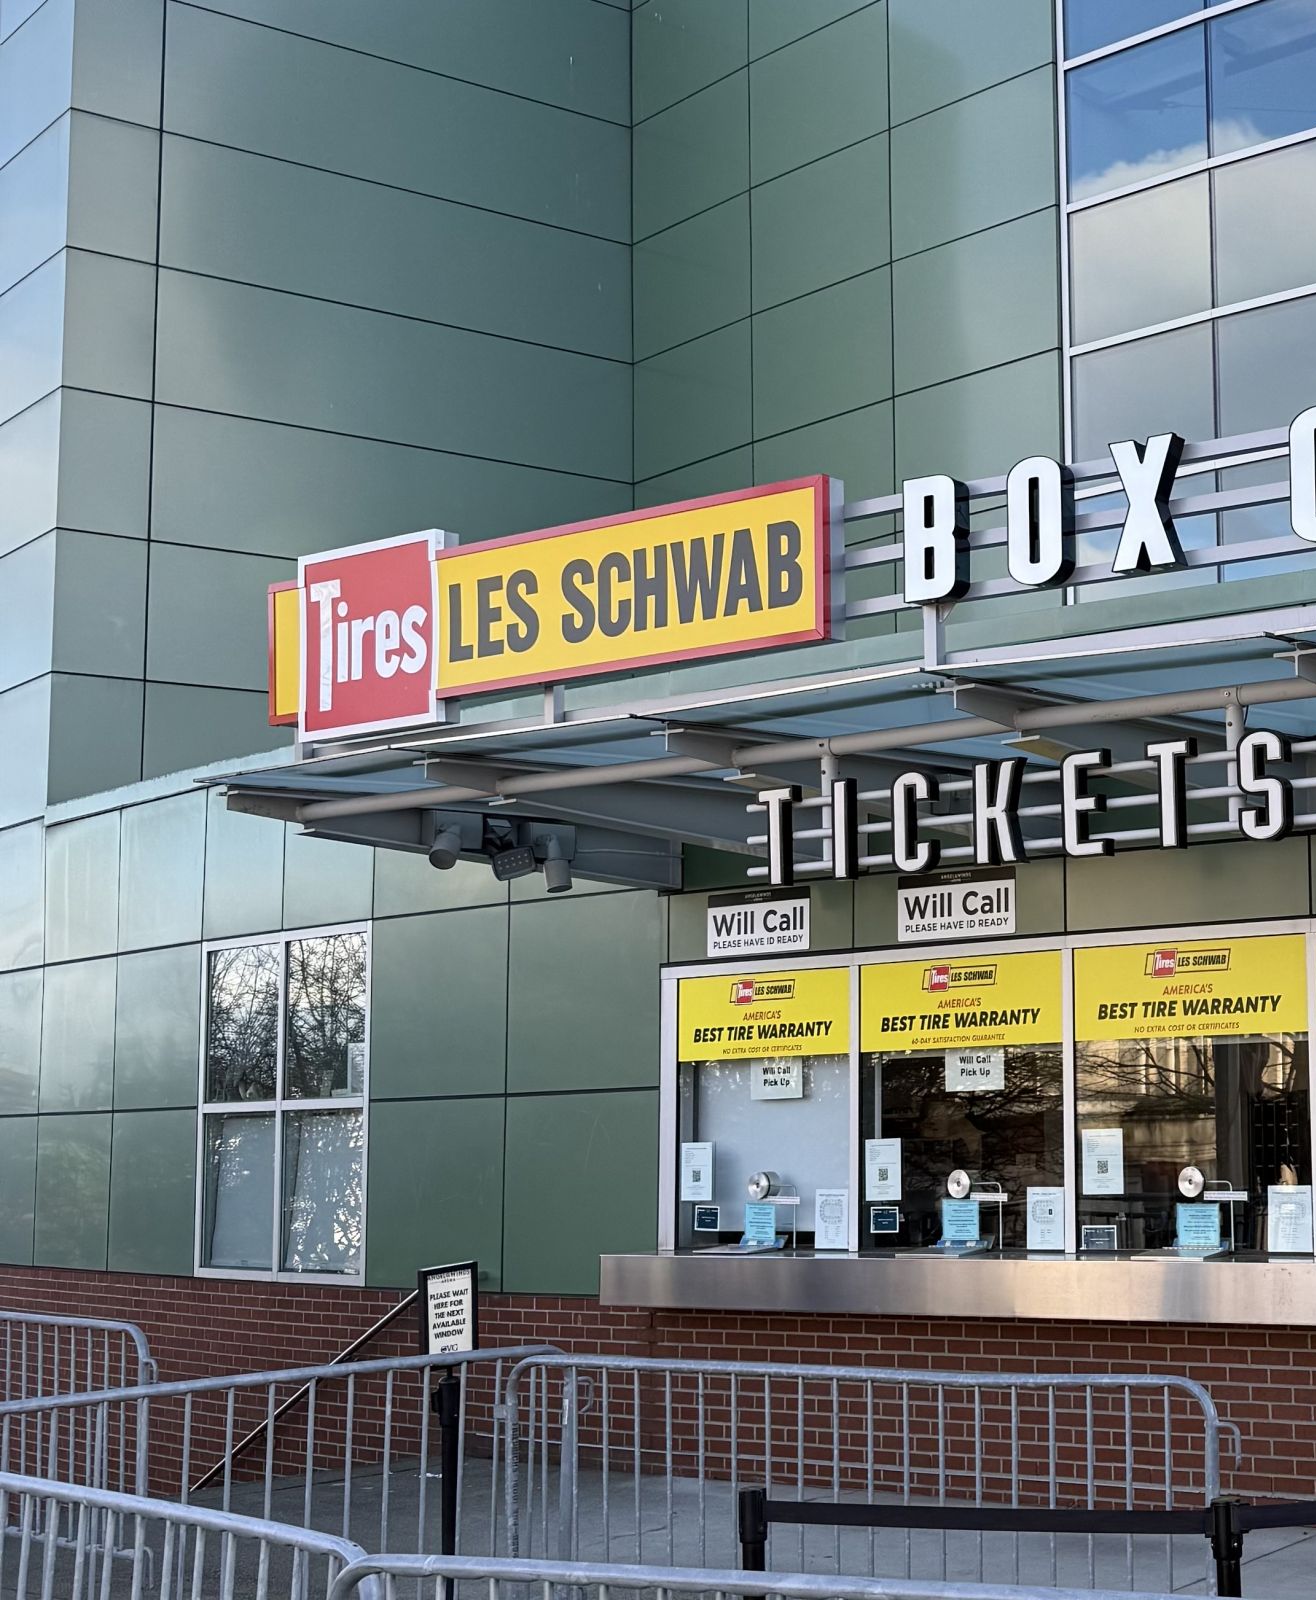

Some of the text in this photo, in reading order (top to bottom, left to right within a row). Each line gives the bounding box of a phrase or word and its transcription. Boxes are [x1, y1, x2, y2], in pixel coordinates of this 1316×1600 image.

[903, 433, 1185, 603] BOX
[448, 520, 802, 663] LES SCHWAB
[310, 578, 427, 712] Tires
[758, 730, 1293, 886] TICKETS
[904, 887, 1009, 920] Will Call
[713, 906, 804, 937] Will Call
[905, 917, 1009, 933] PLEASE HAVE ID READY
[714, 934, 803, 949] PLEASE HAVE ID READY
[1155, 954, 1175, 970] Tires
[1178, 954, 1226, 967] LES SCHWAB
[931, 970, 948, 985] Tires
[951, 970, 993, 982] LES SCHWAB
[755, 985, 791, 995] LES SCHWAB
[1163, 984, 1213, 996] AMERICA'S
[937, 998, 981, 1009] AMERICA'S
[1098, 995, 1282, 1020] BEST TIRE WARRANTY
[743, 1010, 781, 1021] AMERICA'S
[881, 1008, 1041, 1032] BEST TIRE WARRANTY
[694, 1021, 832, 1043] BEST TIRE WARRANTY
[1198, 1022, 1239, 1030] CERTIFICATES
[912, 1033, 1005, 1045] 60-DAY SATISFACTION GUARANTEE
[959, 1055, 991, 1064] Will Call
[762, 1066, 790, 1075] Will Call
[960, 1068, 990, 1078] Pick Up
[764, 1078, 790, 1087] Pick Up
[430, 1288, 468, 1301] PLEASE WAIT
[434, 1299, 463, 1310] HERE FOR
[435, 1308, 464, 1319] THE NEXT
[433, 1318, 466, 1330] AVAILABLE
[434, 1328, 464, 1340] WINDOW
